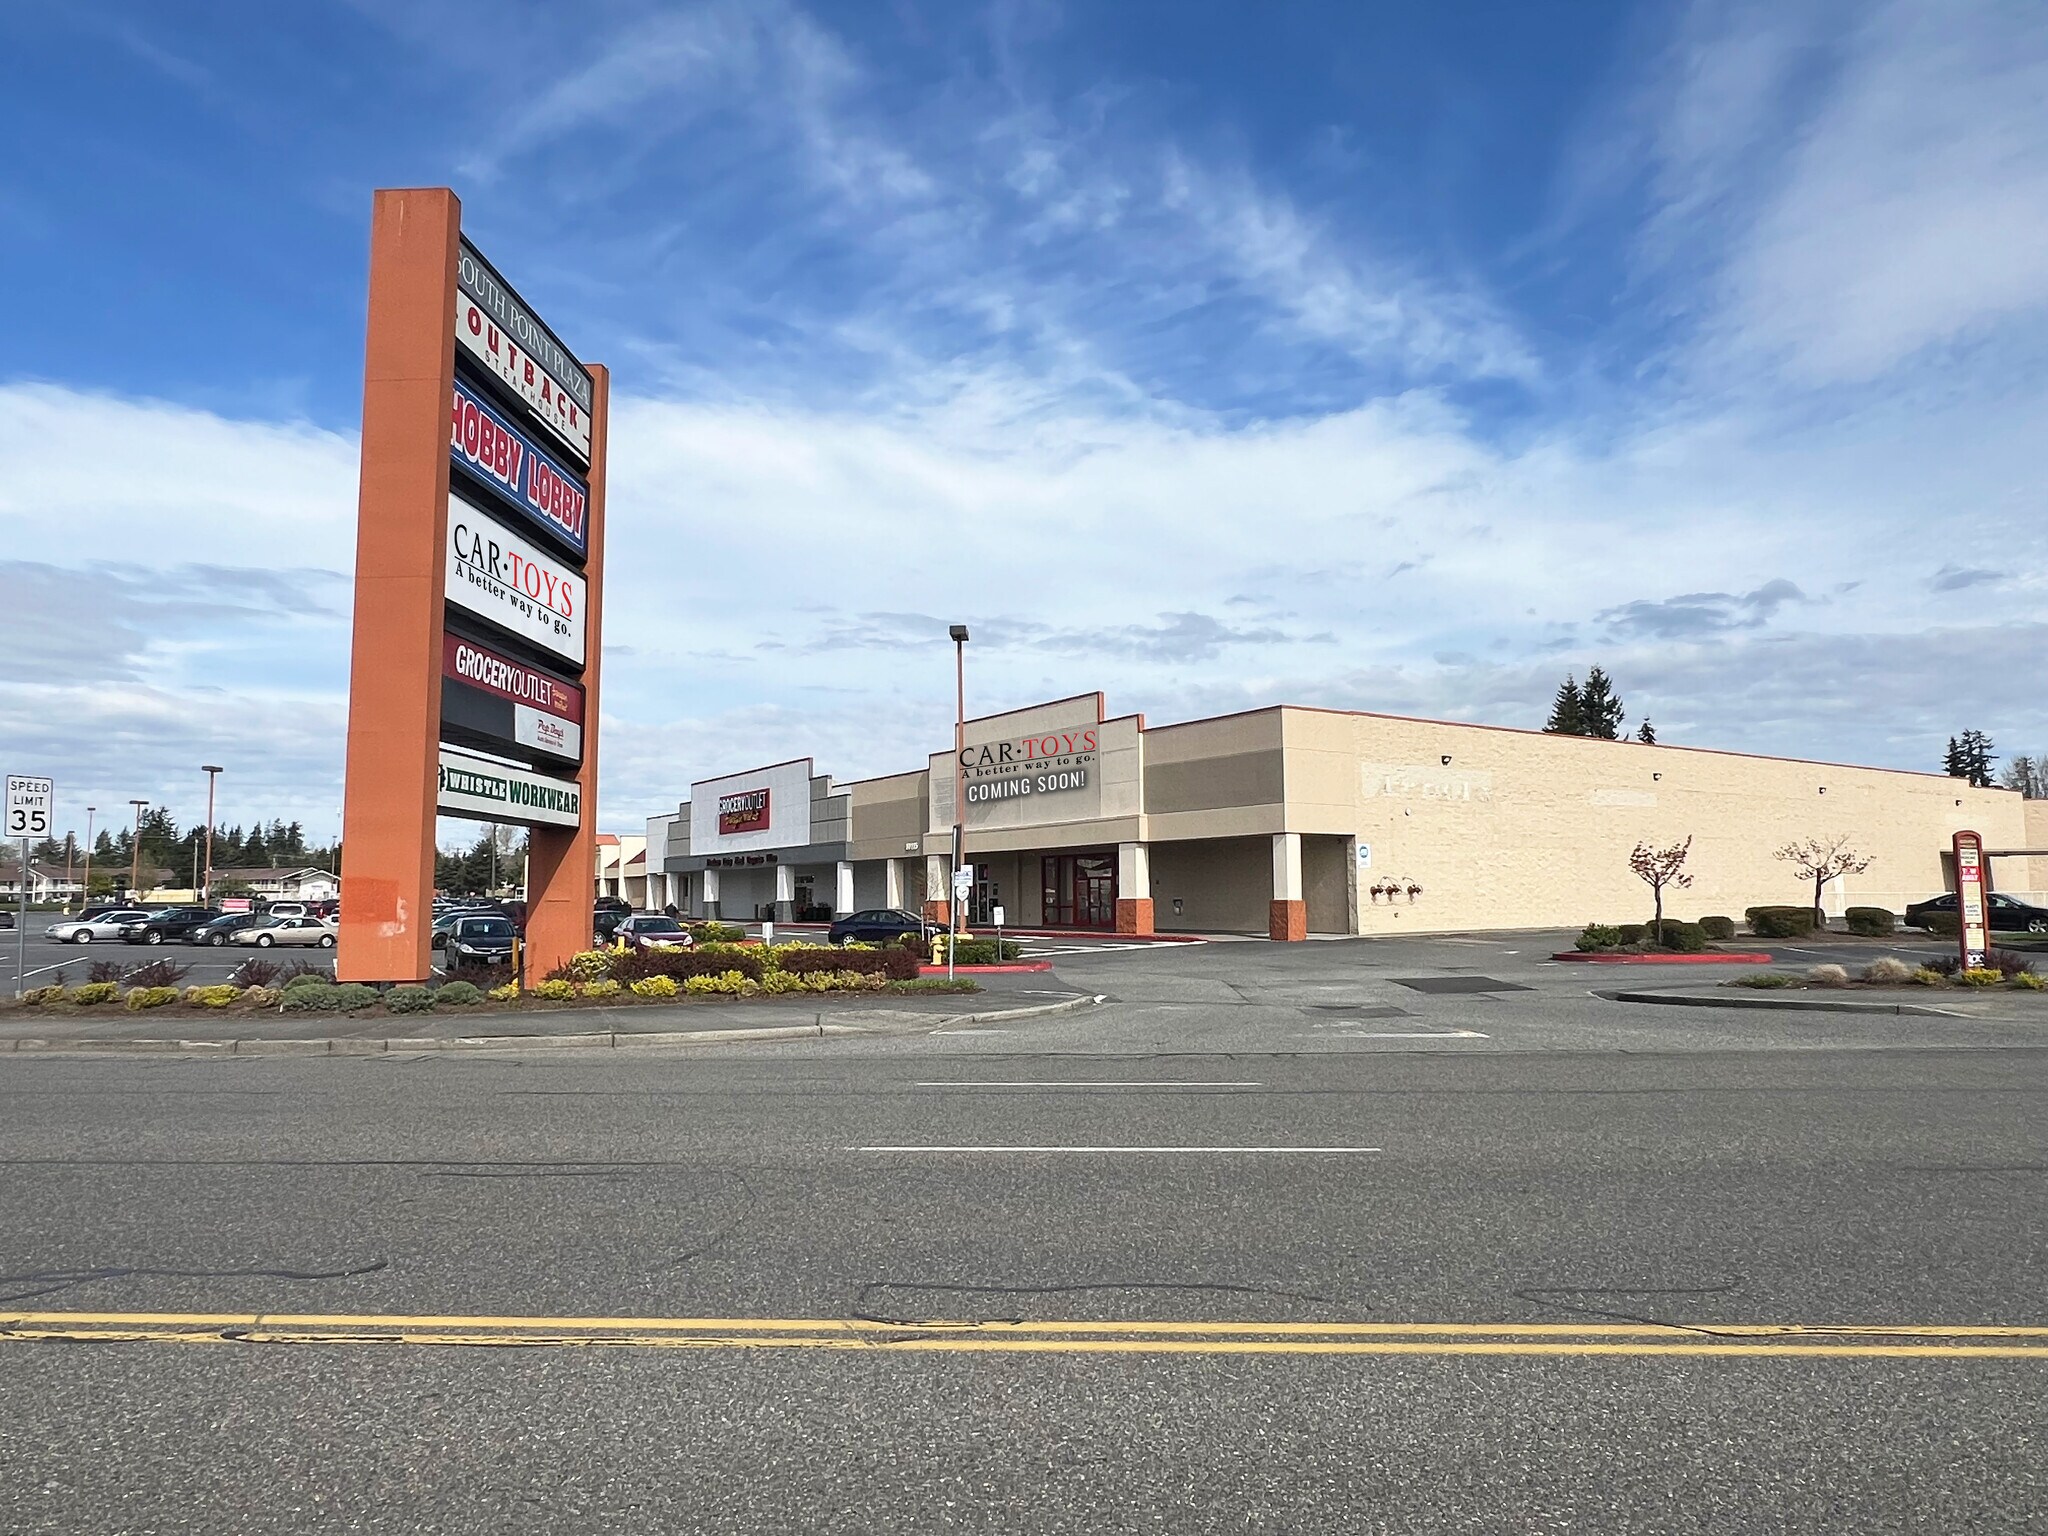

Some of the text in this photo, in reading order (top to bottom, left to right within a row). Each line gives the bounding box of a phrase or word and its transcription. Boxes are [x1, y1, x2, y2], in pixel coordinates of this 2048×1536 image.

[468, 307, 579, 430] OUTBACK
[510, 304, 550, 363] POINT
[554, 350, 591, 405] PLAZA
[485, 350, 566, 431] STEAKHOUSE
[452, 389, 585, 540] HOBBY LOBBY
[455, 561, 571, 637] A better way to go.
[10, 781, 50, 793] SPEED
[961, 755, 1095, 779] A better way to go.
[968, 770, 1085, 802] COMING SOON!
[14, 795, 44, 806] LIMIT
[449, 771, 578, 814] WHISTLE WORKWEAR
[11, 809, 46, 832] 35
